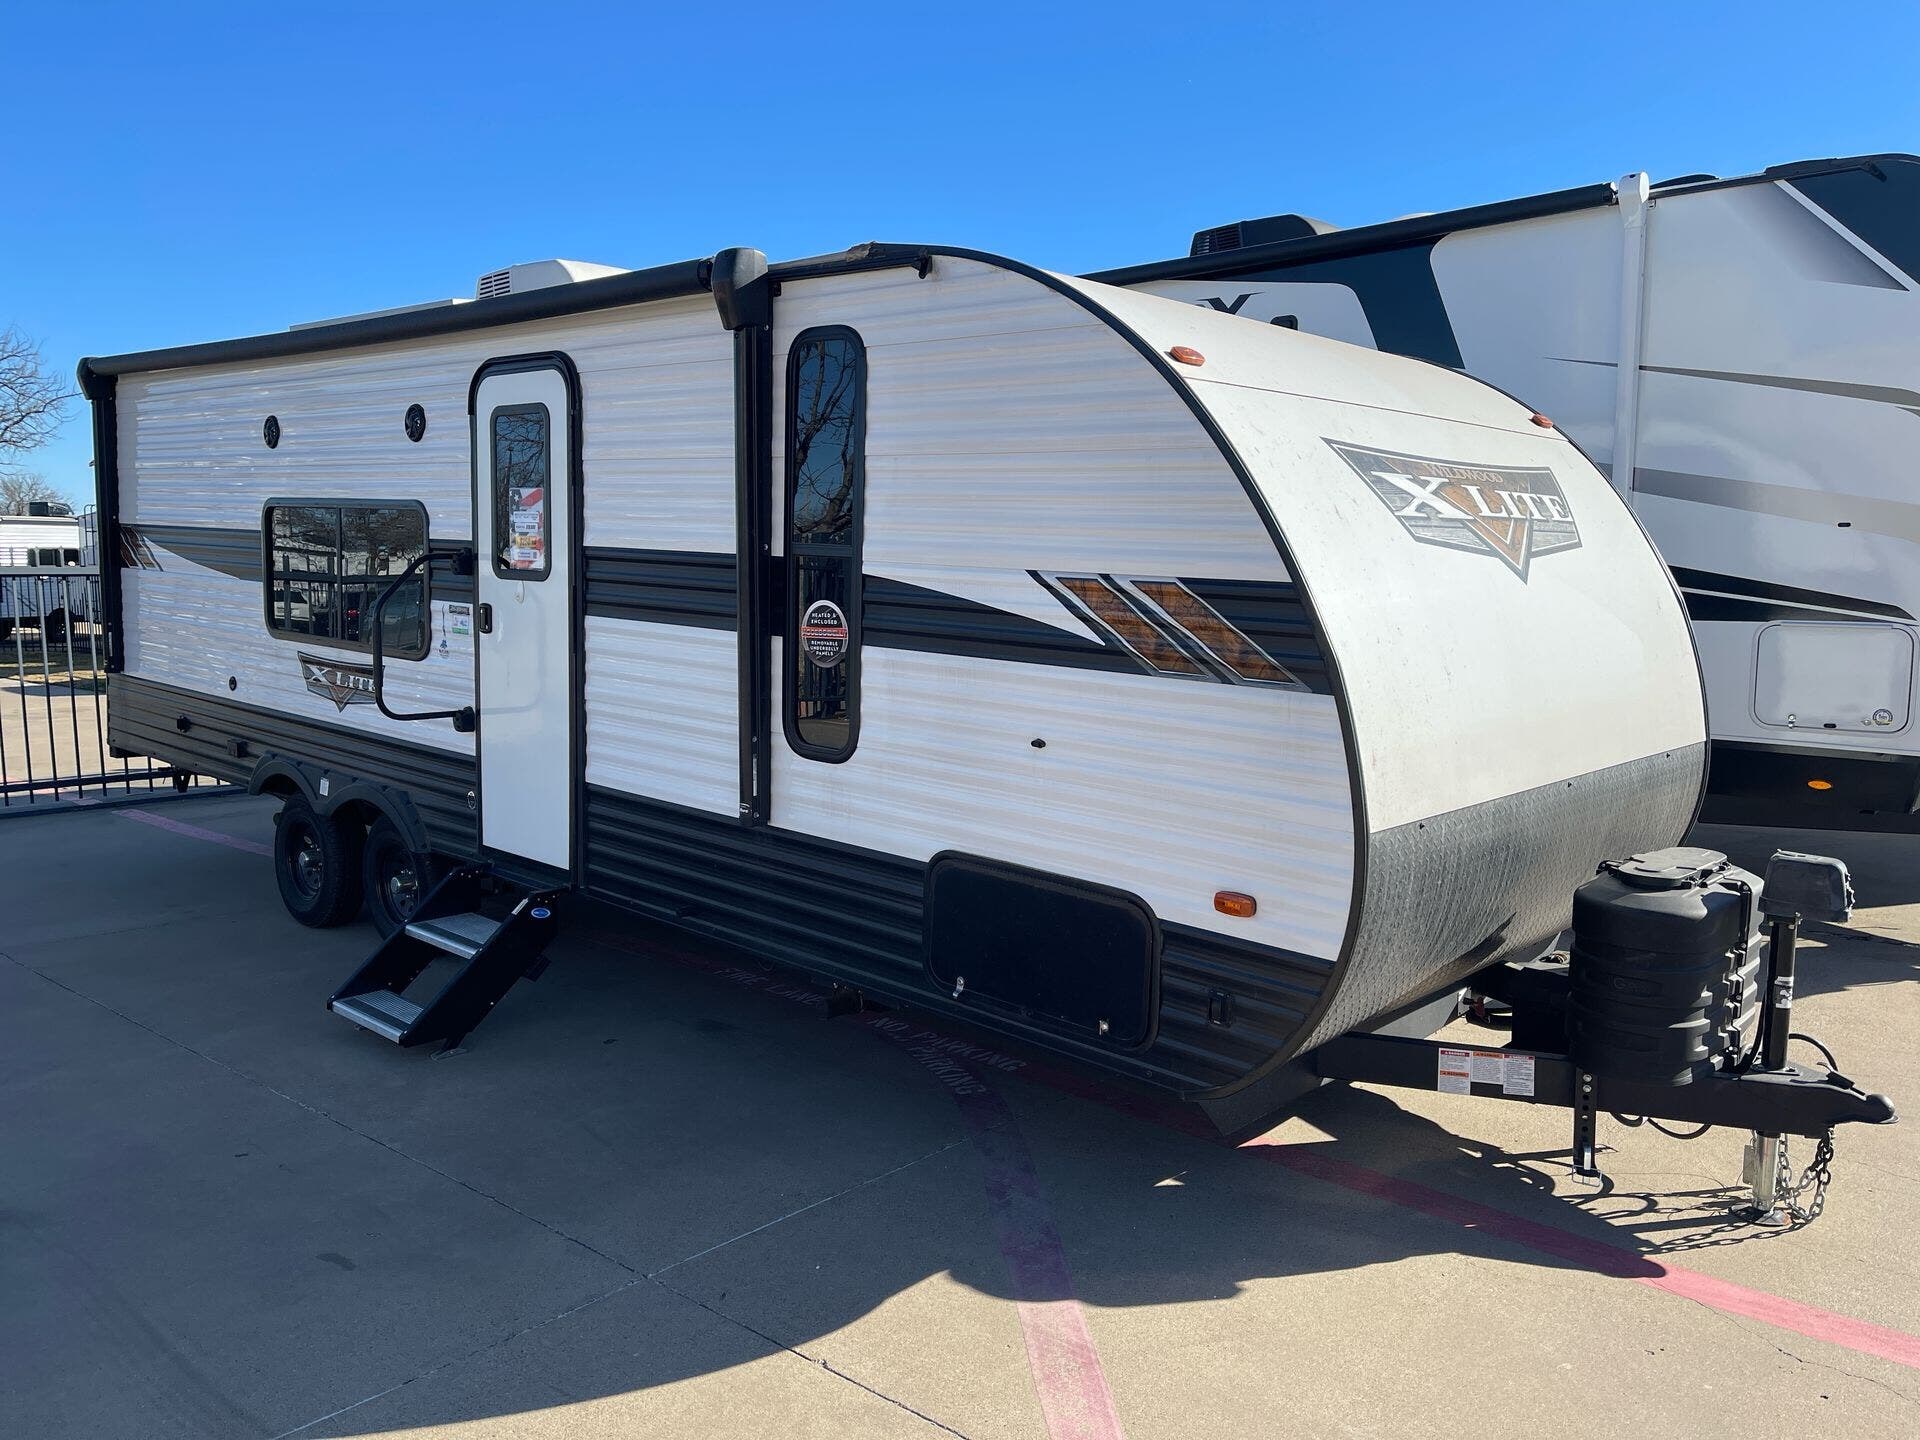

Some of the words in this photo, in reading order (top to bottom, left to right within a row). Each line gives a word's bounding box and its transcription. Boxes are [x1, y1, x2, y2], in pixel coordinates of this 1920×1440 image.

[1424, 463, 1504, 483] WILDWOOD
[1370, 470, 1476, 520] X
[1461, 484, 1574, 522] LITE
[305, 663, 333, 687] X
[865, 1016, 911, 1032] NO
[908, 1031, 1027, 1072] PARKING
